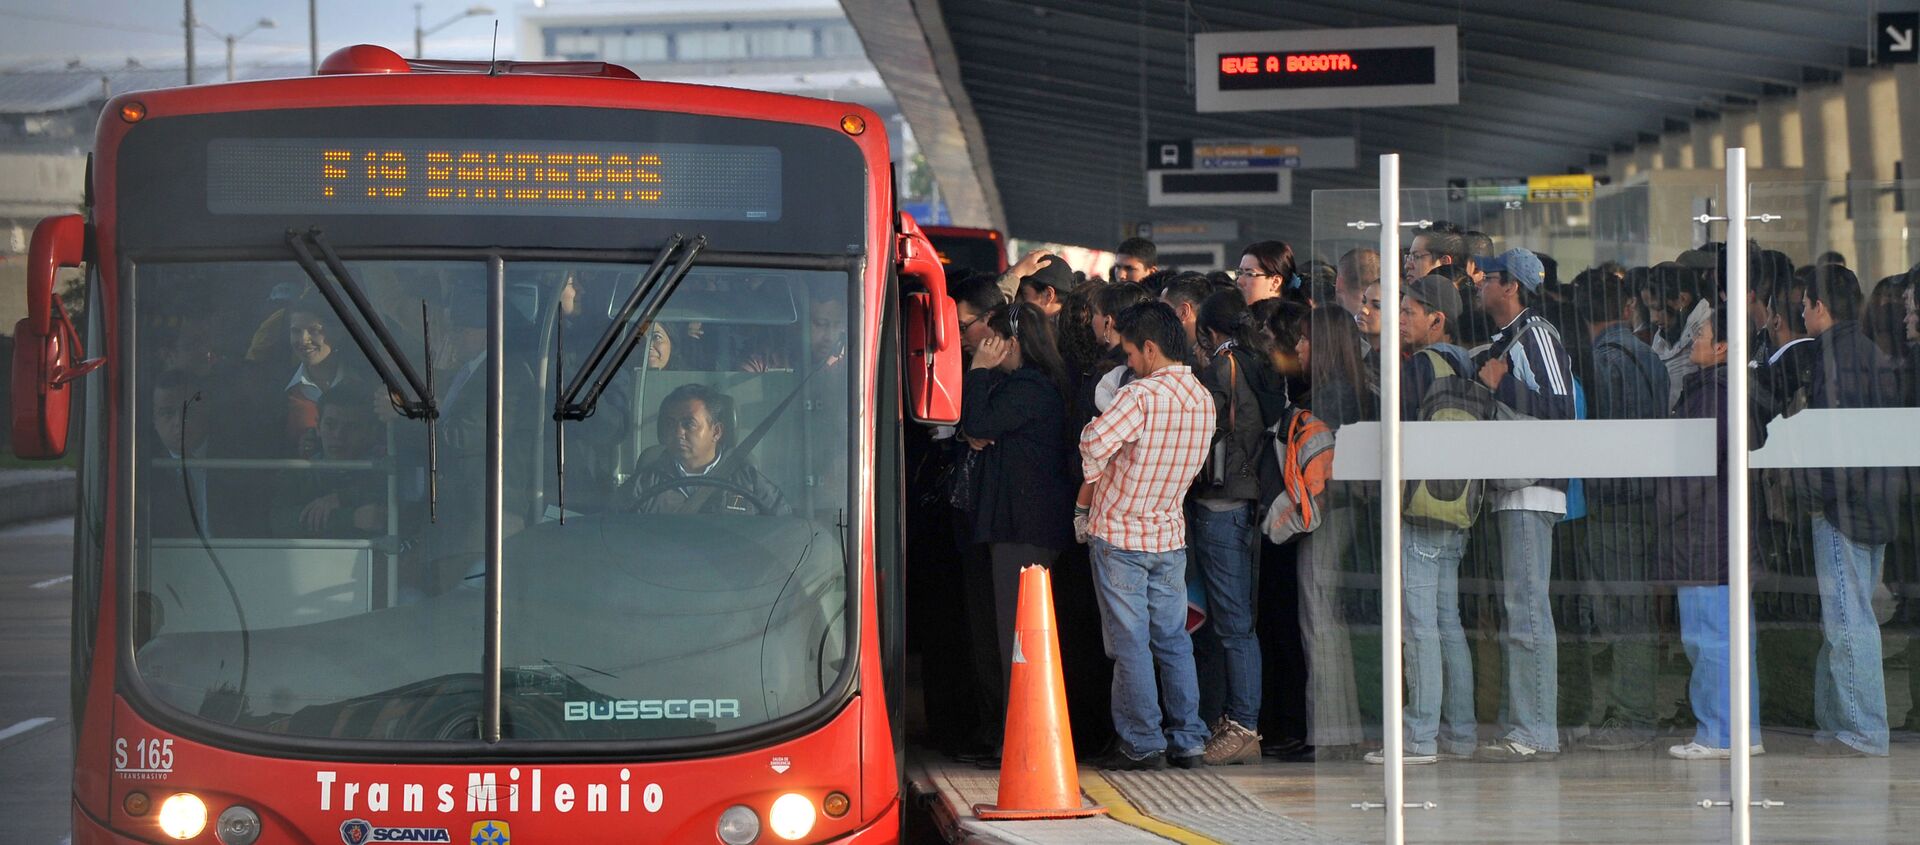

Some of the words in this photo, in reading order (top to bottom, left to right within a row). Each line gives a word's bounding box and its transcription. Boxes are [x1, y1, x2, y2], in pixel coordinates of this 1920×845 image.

[1266, 56, 1279, 72] A
[1287, 54, 1358, 71] BOGOTA.
[323, 151, 350, 196] F
[364, 151, 406, 197] 19
[427, 151, 663, 200] BANDERAS
[565, 699, 740, 721] BUSSCAR
[115, 737, 128, 769] S
[137, 738, 174, 769] 165
[317, 767, 663, 813] TransMilenio
[373, 828, 450, 842] SCANIA
